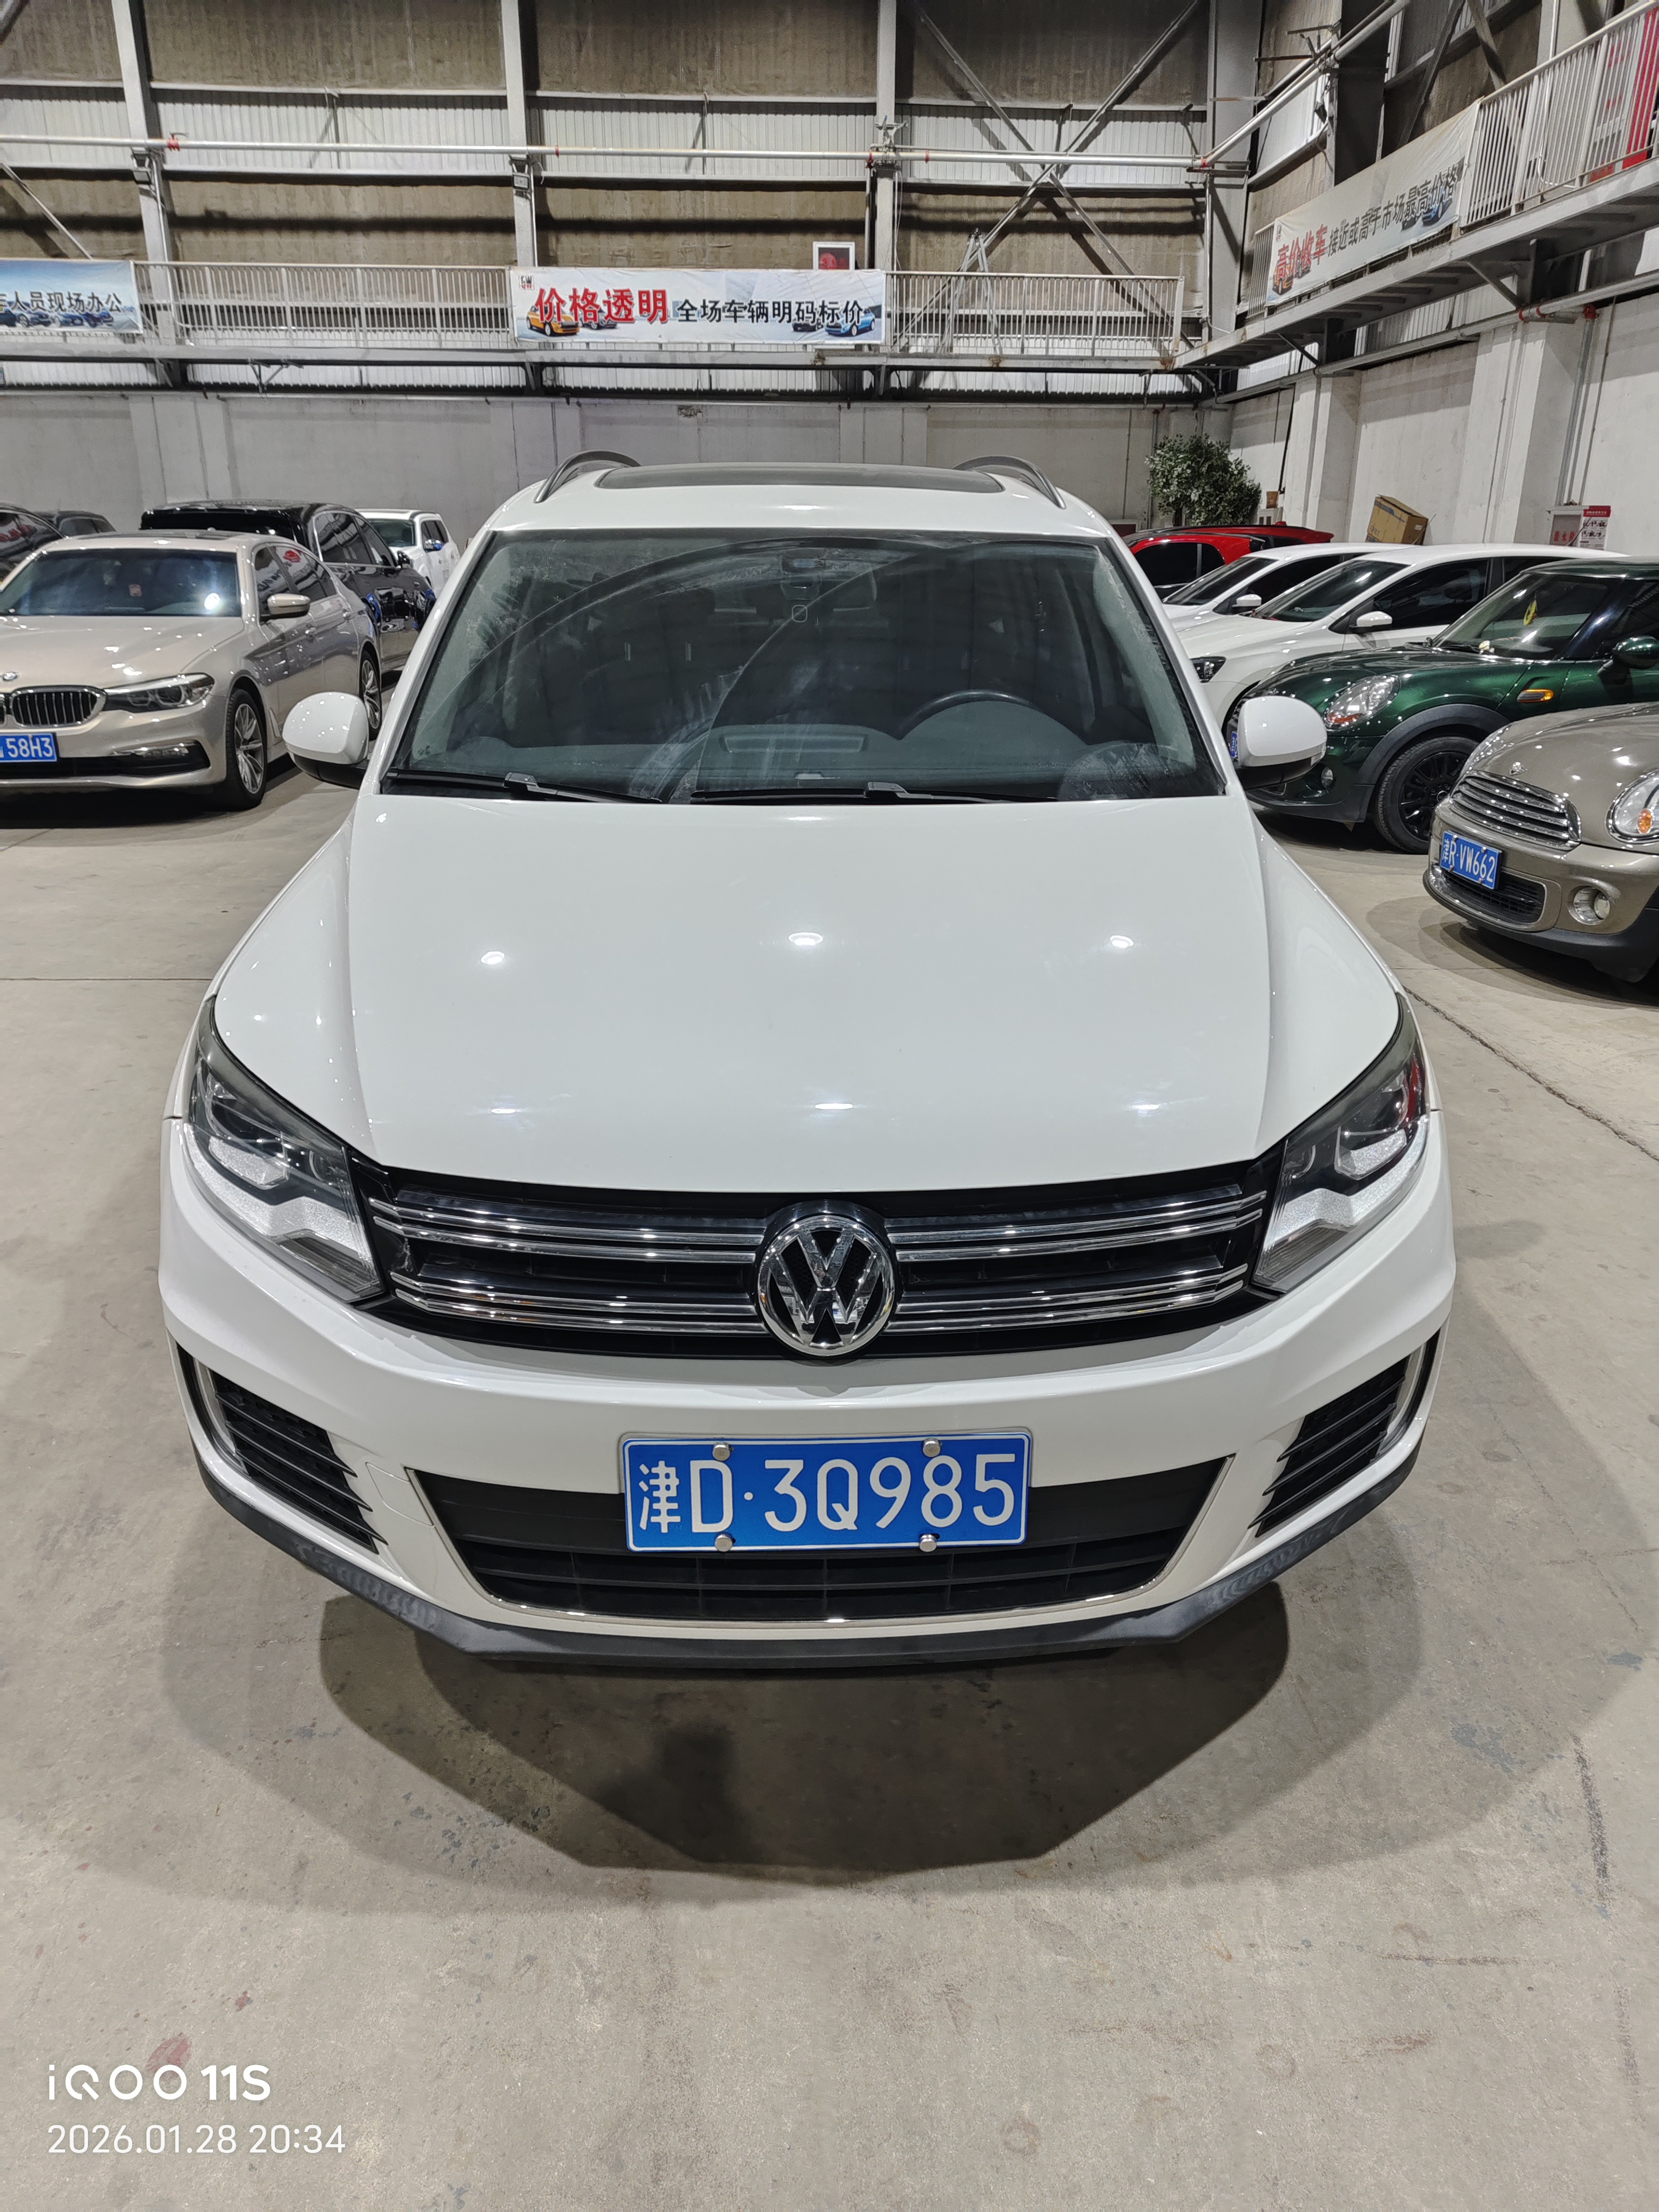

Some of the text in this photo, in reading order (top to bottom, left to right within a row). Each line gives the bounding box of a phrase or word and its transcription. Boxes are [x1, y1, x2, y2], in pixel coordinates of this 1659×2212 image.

[1276, 163, 1459, 282] 高价收车 接近或高于市场最高价格
[535, 287, 864, 324] 价格透明 全场车辆明码标价
[0, 737, 53, 758] 58H3
